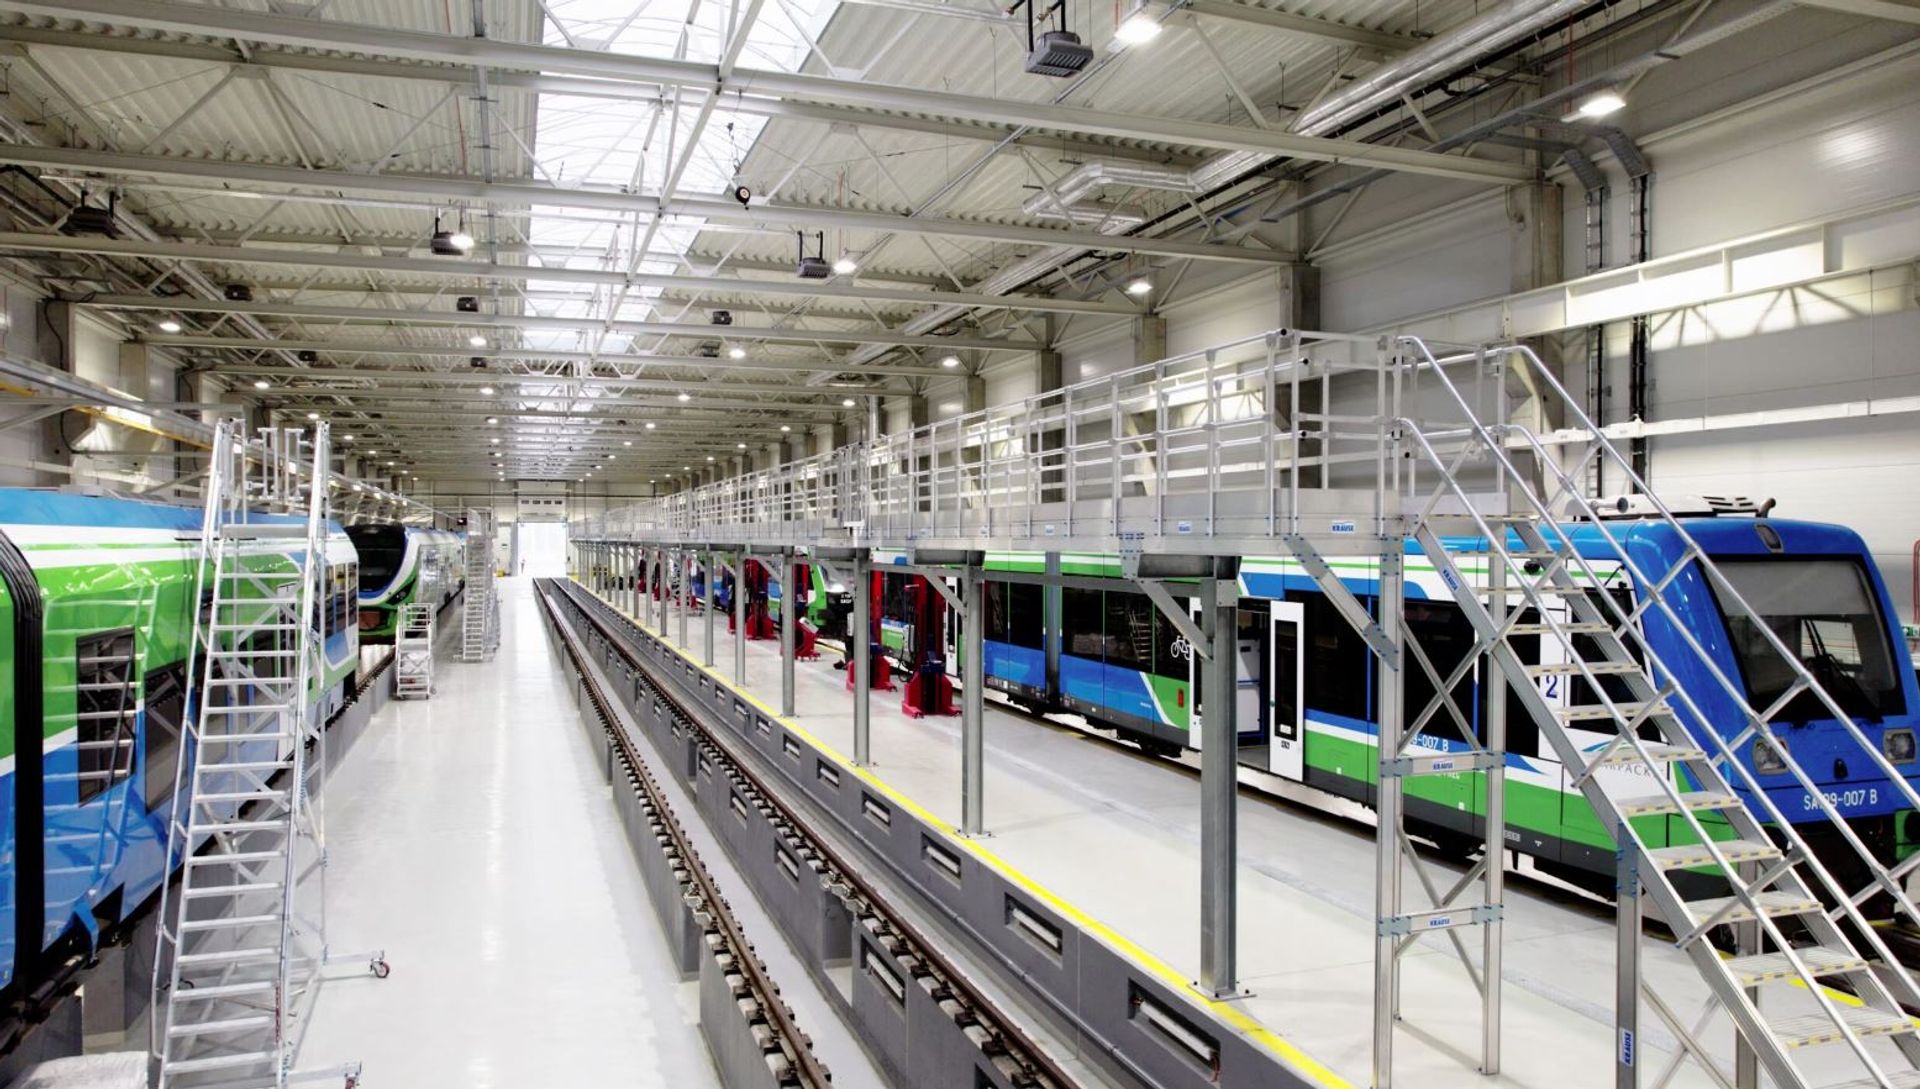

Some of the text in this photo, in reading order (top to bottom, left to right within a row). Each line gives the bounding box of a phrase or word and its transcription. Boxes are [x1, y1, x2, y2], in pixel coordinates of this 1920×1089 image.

[1545, 675, 1558, 699] 2
[1442, 738, 1449, 752] B
[1869, 788, 1878, 805] B
[1624, 1031, 1632, 1065] KRAUSE
